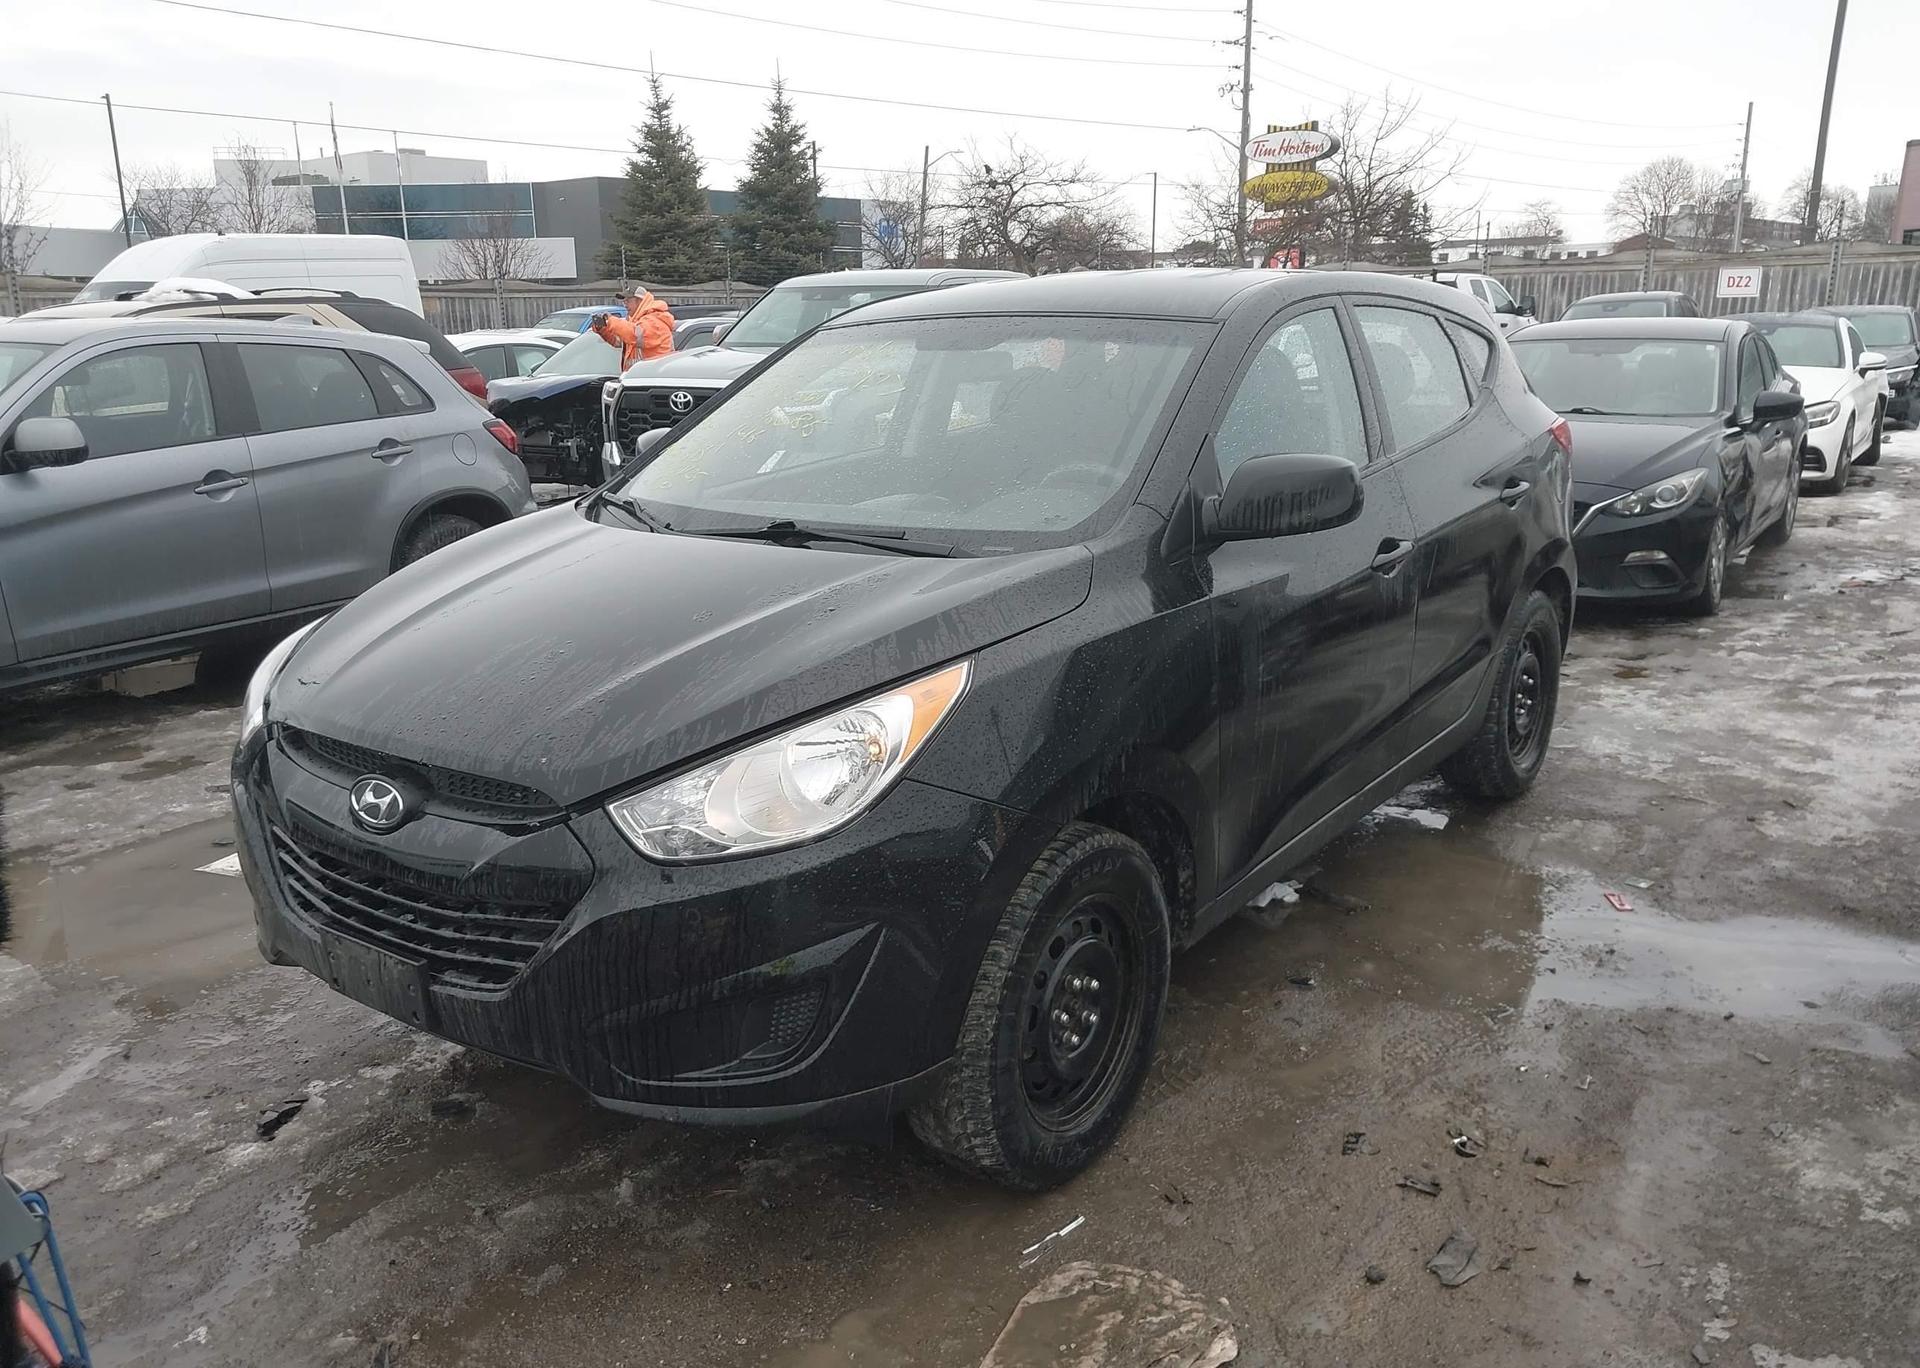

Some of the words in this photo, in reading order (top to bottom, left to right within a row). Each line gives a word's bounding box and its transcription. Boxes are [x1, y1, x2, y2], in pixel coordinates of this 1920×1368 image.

[1252, 139, 1278, 158] Tim
[1277, 138, 1324, 156] Hortons
[1727, 275, 1752, 288] DZ2
